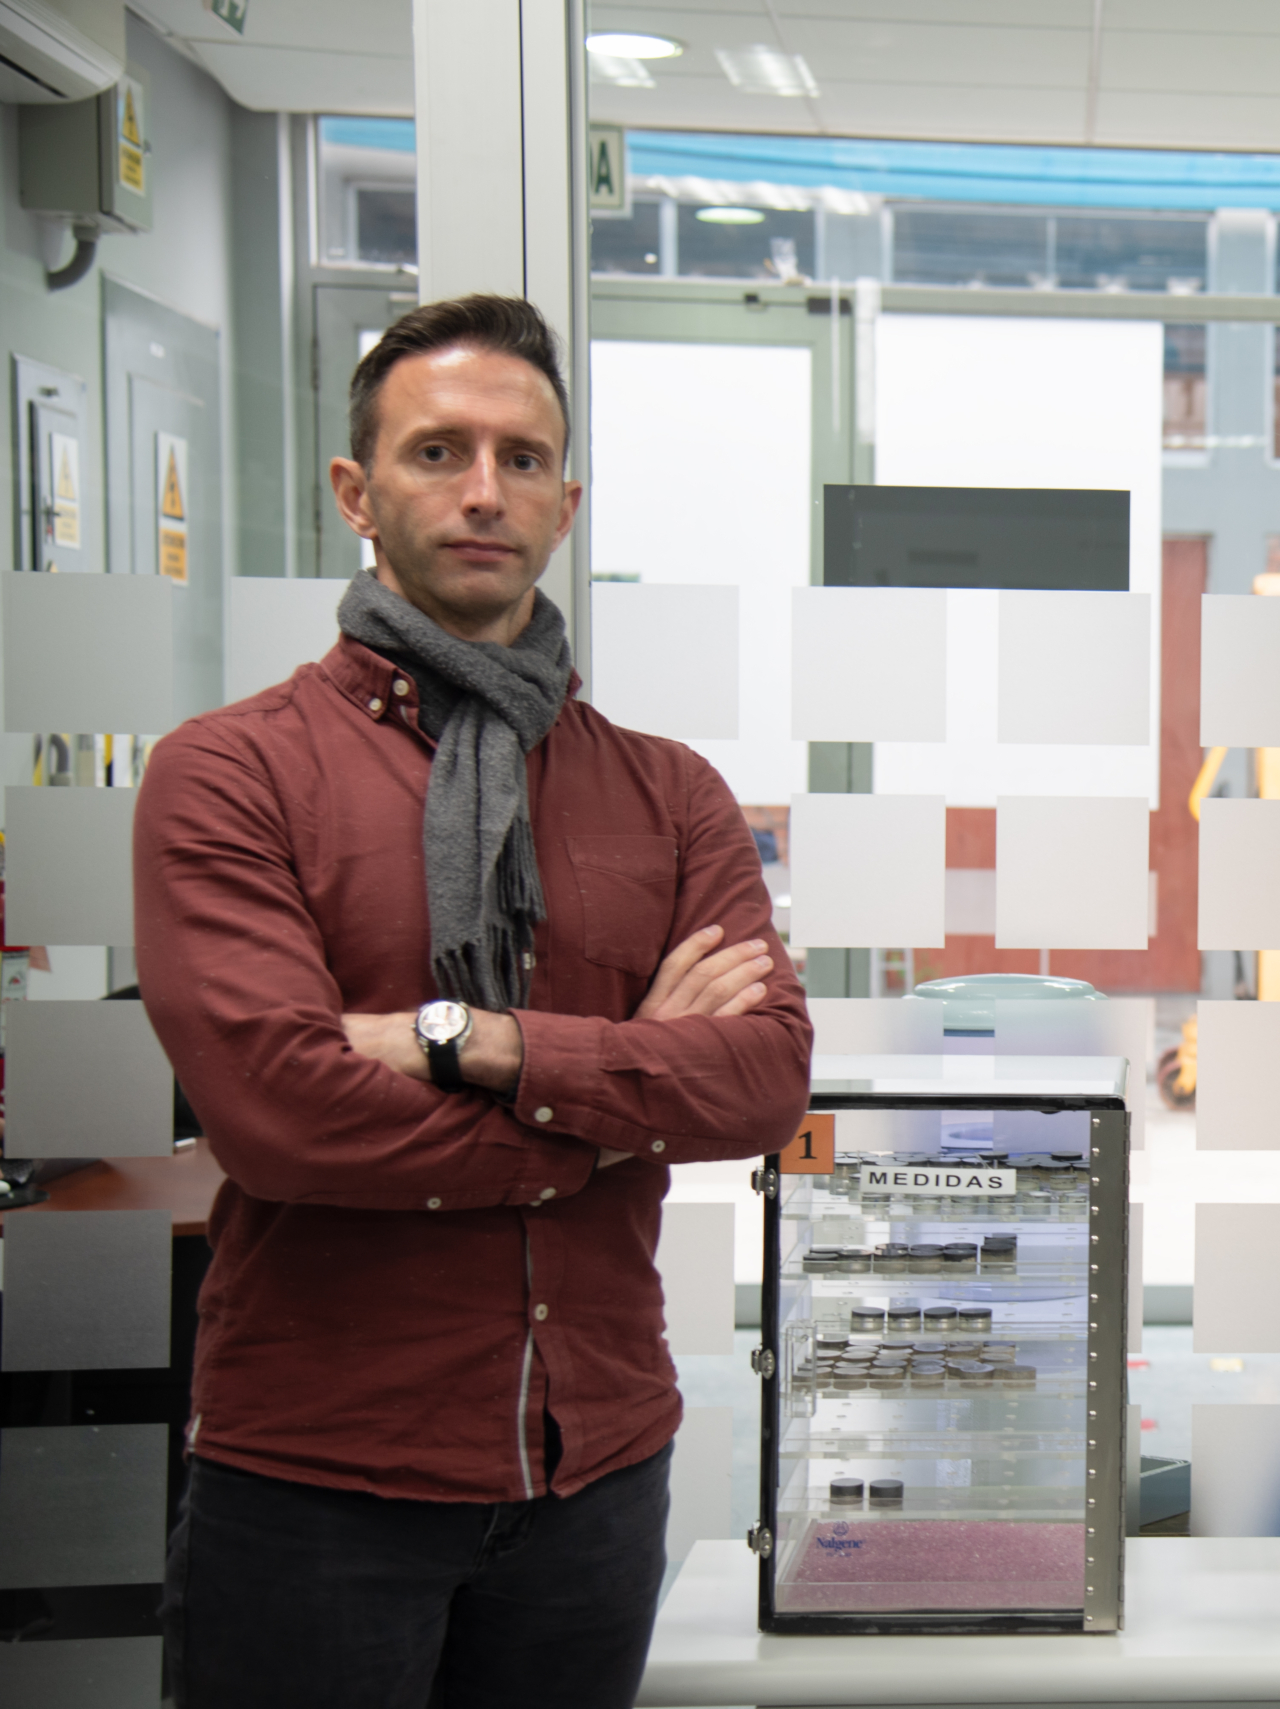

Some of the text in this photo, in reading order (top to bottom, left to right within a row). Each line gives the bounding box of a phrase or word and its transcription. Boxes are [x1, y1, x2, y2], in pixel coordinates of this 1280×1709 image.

[590, 139, 614, 195] A
[798, 1130, 818, 1160] 1
[868, 1171, 1003, 1190] MEDIDAS
[816, 1537, 863, 1552] Nalgene
